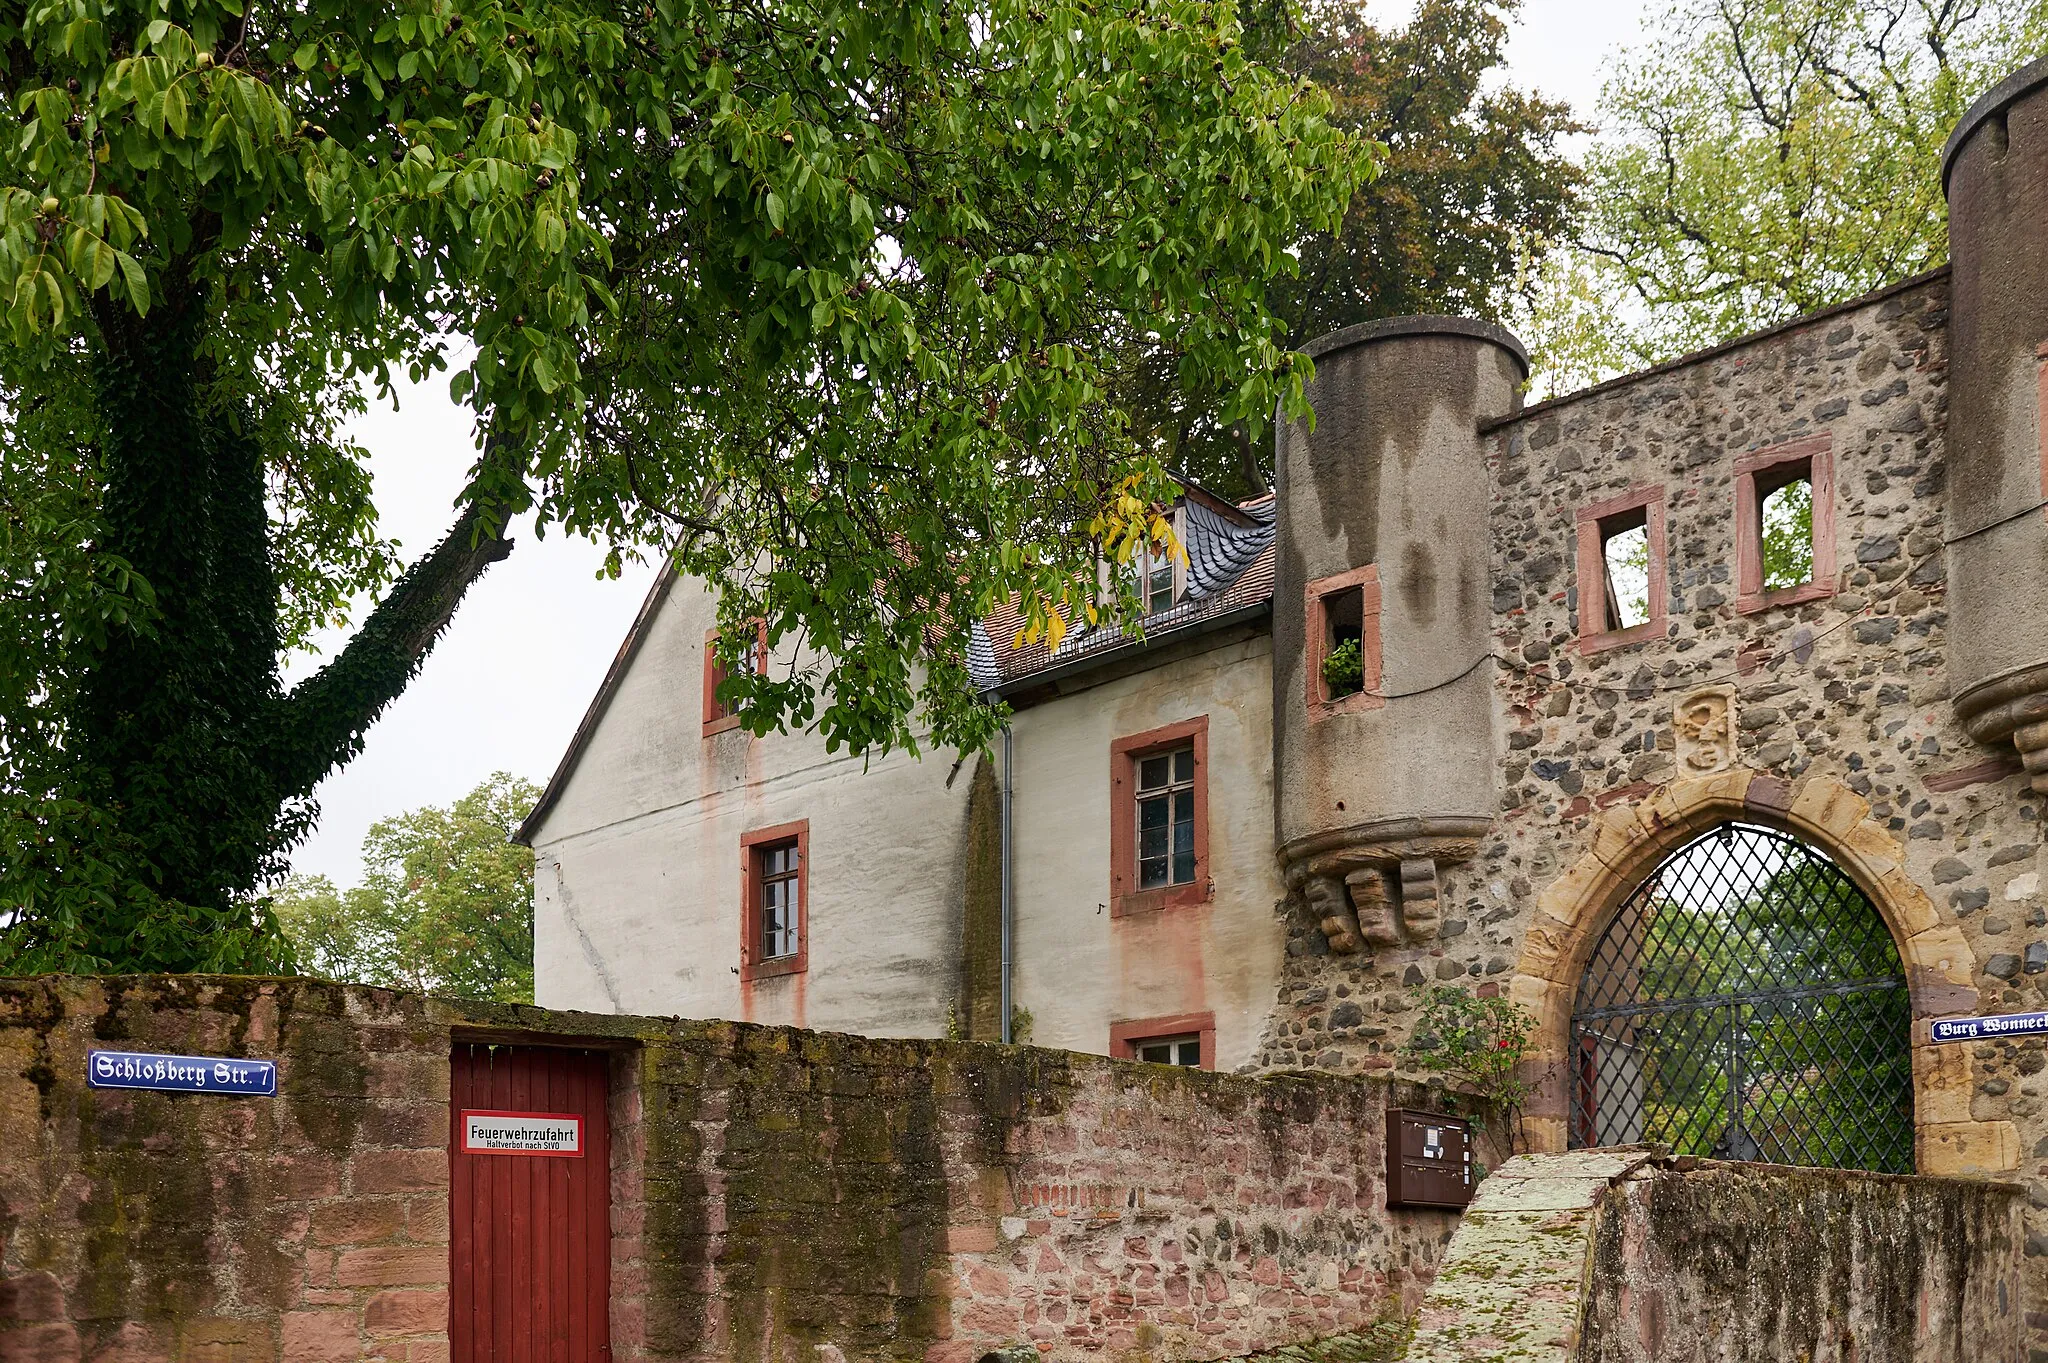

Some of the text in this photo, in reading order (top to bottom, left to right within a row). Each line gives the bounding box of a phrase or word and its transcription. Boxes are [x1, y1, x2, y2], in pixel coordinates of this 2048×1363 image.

[1939, 1022, 1978, 1036] Burg
[96, 1056, 269, 1086] Schloßberg Str. 7
[471, 1125, 574, 1141] Feuerwehrzufahrt
[486, 1140, 523, 1149] Haltverbot
[543, 1142, 560, 1150] StVO
